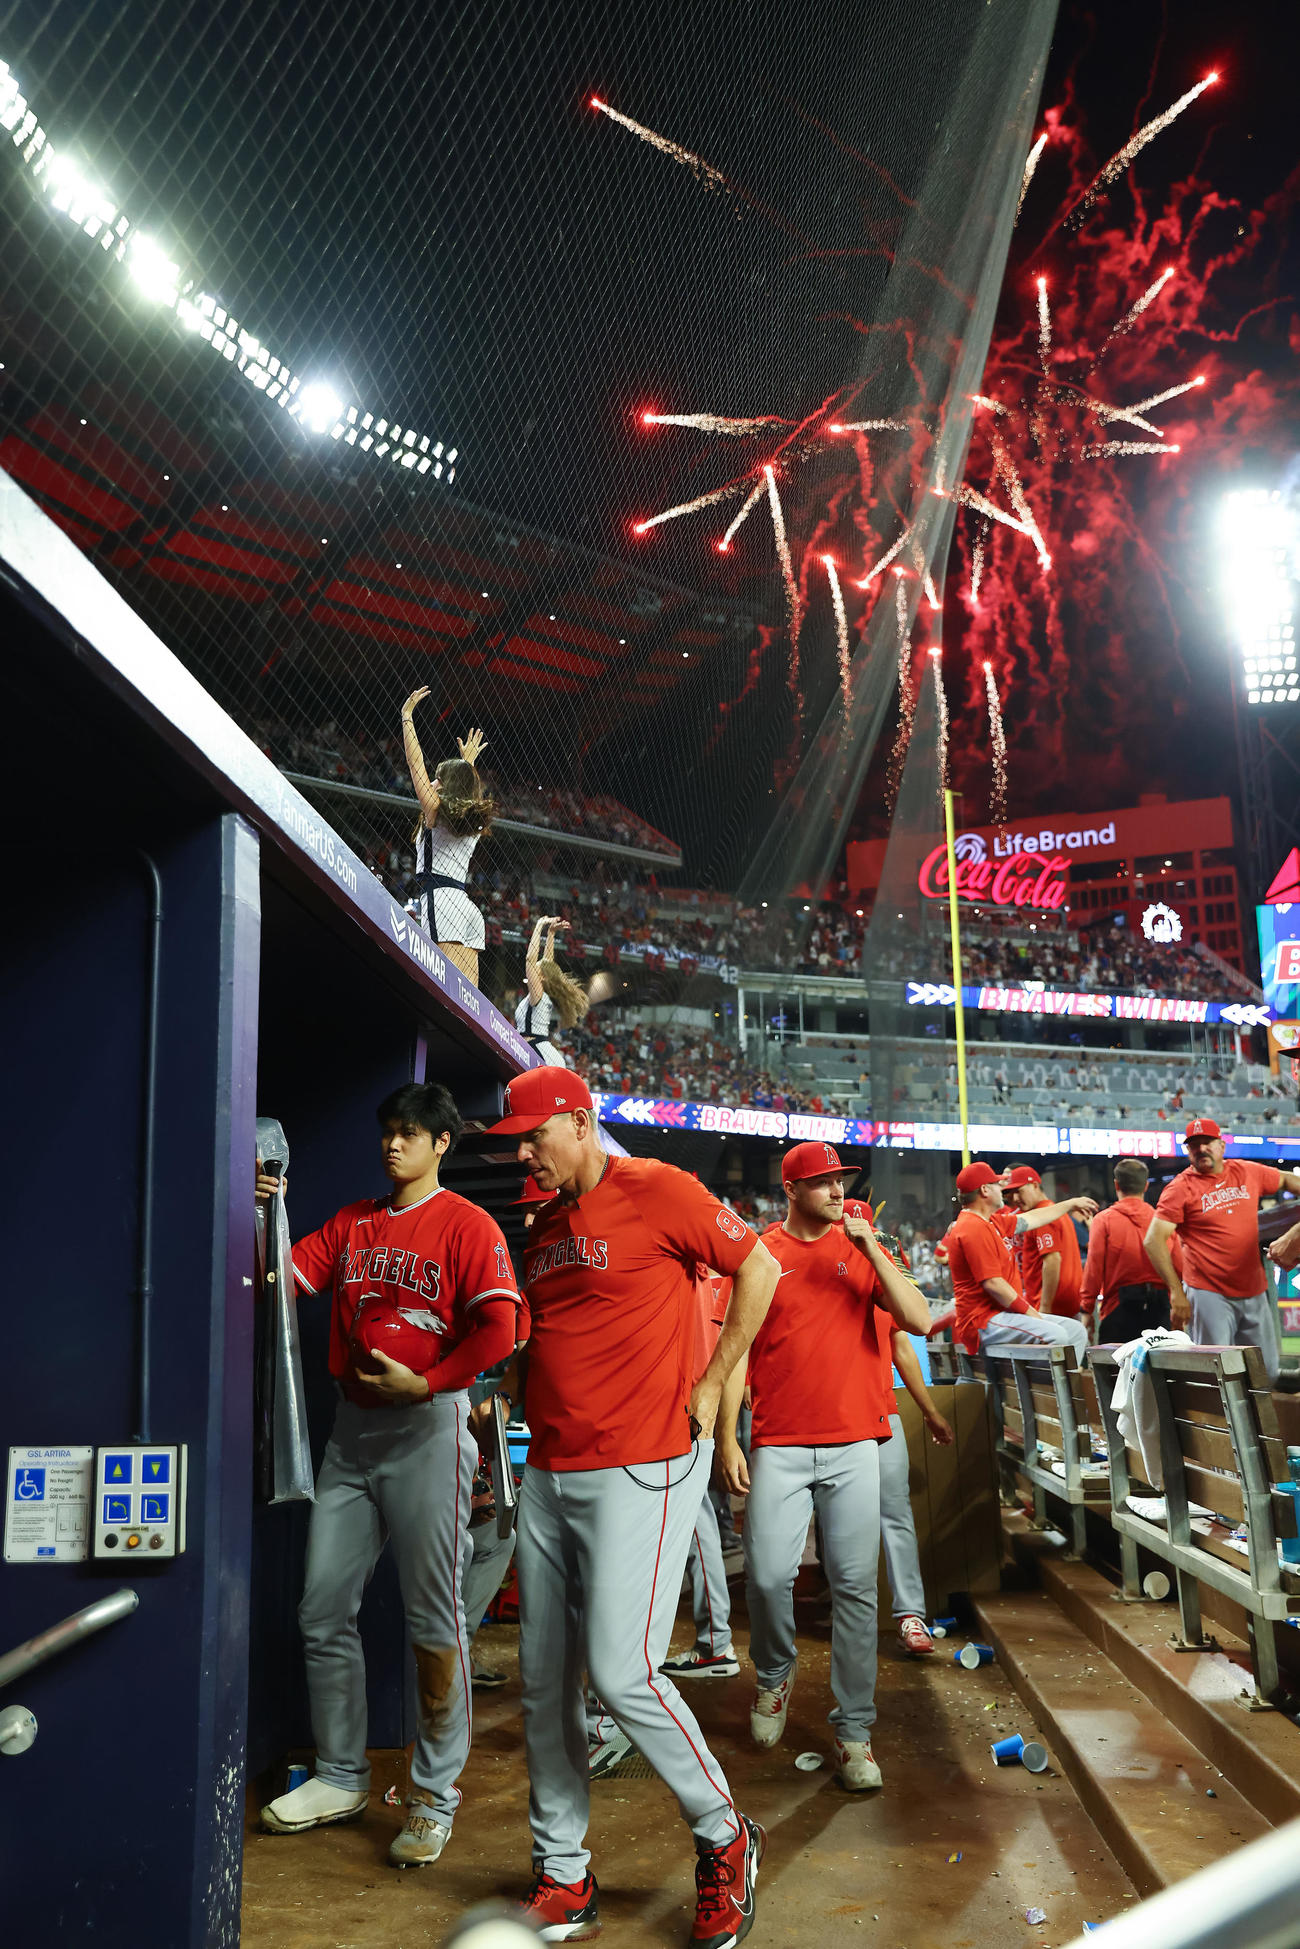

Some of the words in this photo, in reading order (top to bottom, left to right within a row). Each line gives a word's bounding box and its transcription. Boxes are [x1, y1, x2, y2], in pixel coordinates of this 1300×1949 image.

[276, 783, 357, 893] YanmarUS.com
[994, 822, 1116, 857] LifeBrand
[408, 925, 446, 985] YANMAR
[718, 964, 739, 984] 42
[458, 977, 480, 1016] Tractors
[978, 986, 1112, 1017] BRAVES
[701, 1105, 788, 1138] BRAVES
[338, 1242, 442, 1301] ANGELS
[528, 1236, 608, 1285] ANGELS
[27, 1450, 42, 1458] GSL
